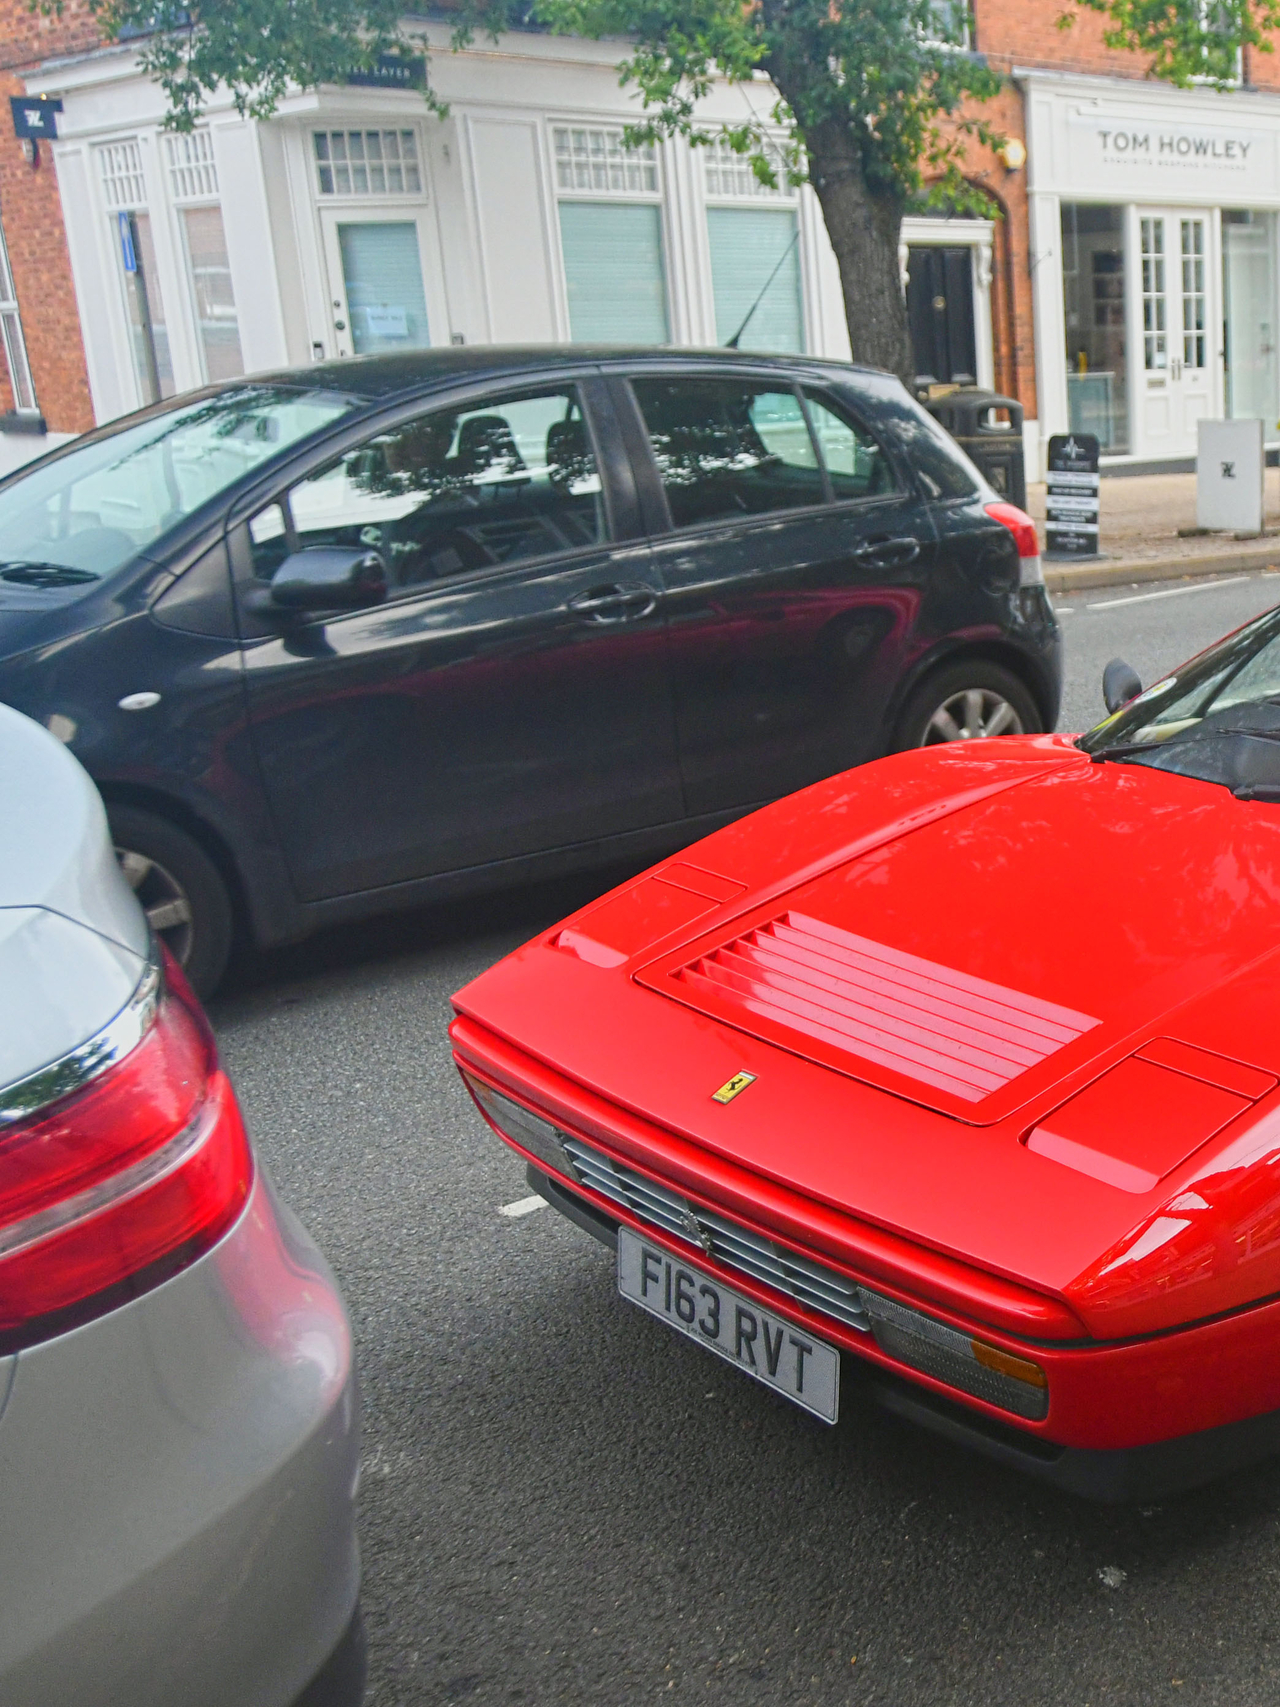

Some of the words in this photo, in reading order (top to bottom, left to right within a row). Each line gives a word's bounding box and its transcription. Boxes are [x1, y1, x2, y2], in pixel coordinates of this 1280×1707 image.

[1098, 130, 1150, 152] TOM
[1158, 136, 1252, 158] HOWLEY
[641, 1246, 721, 1340] F163
[735, 1304, 813, 1394] RVT
